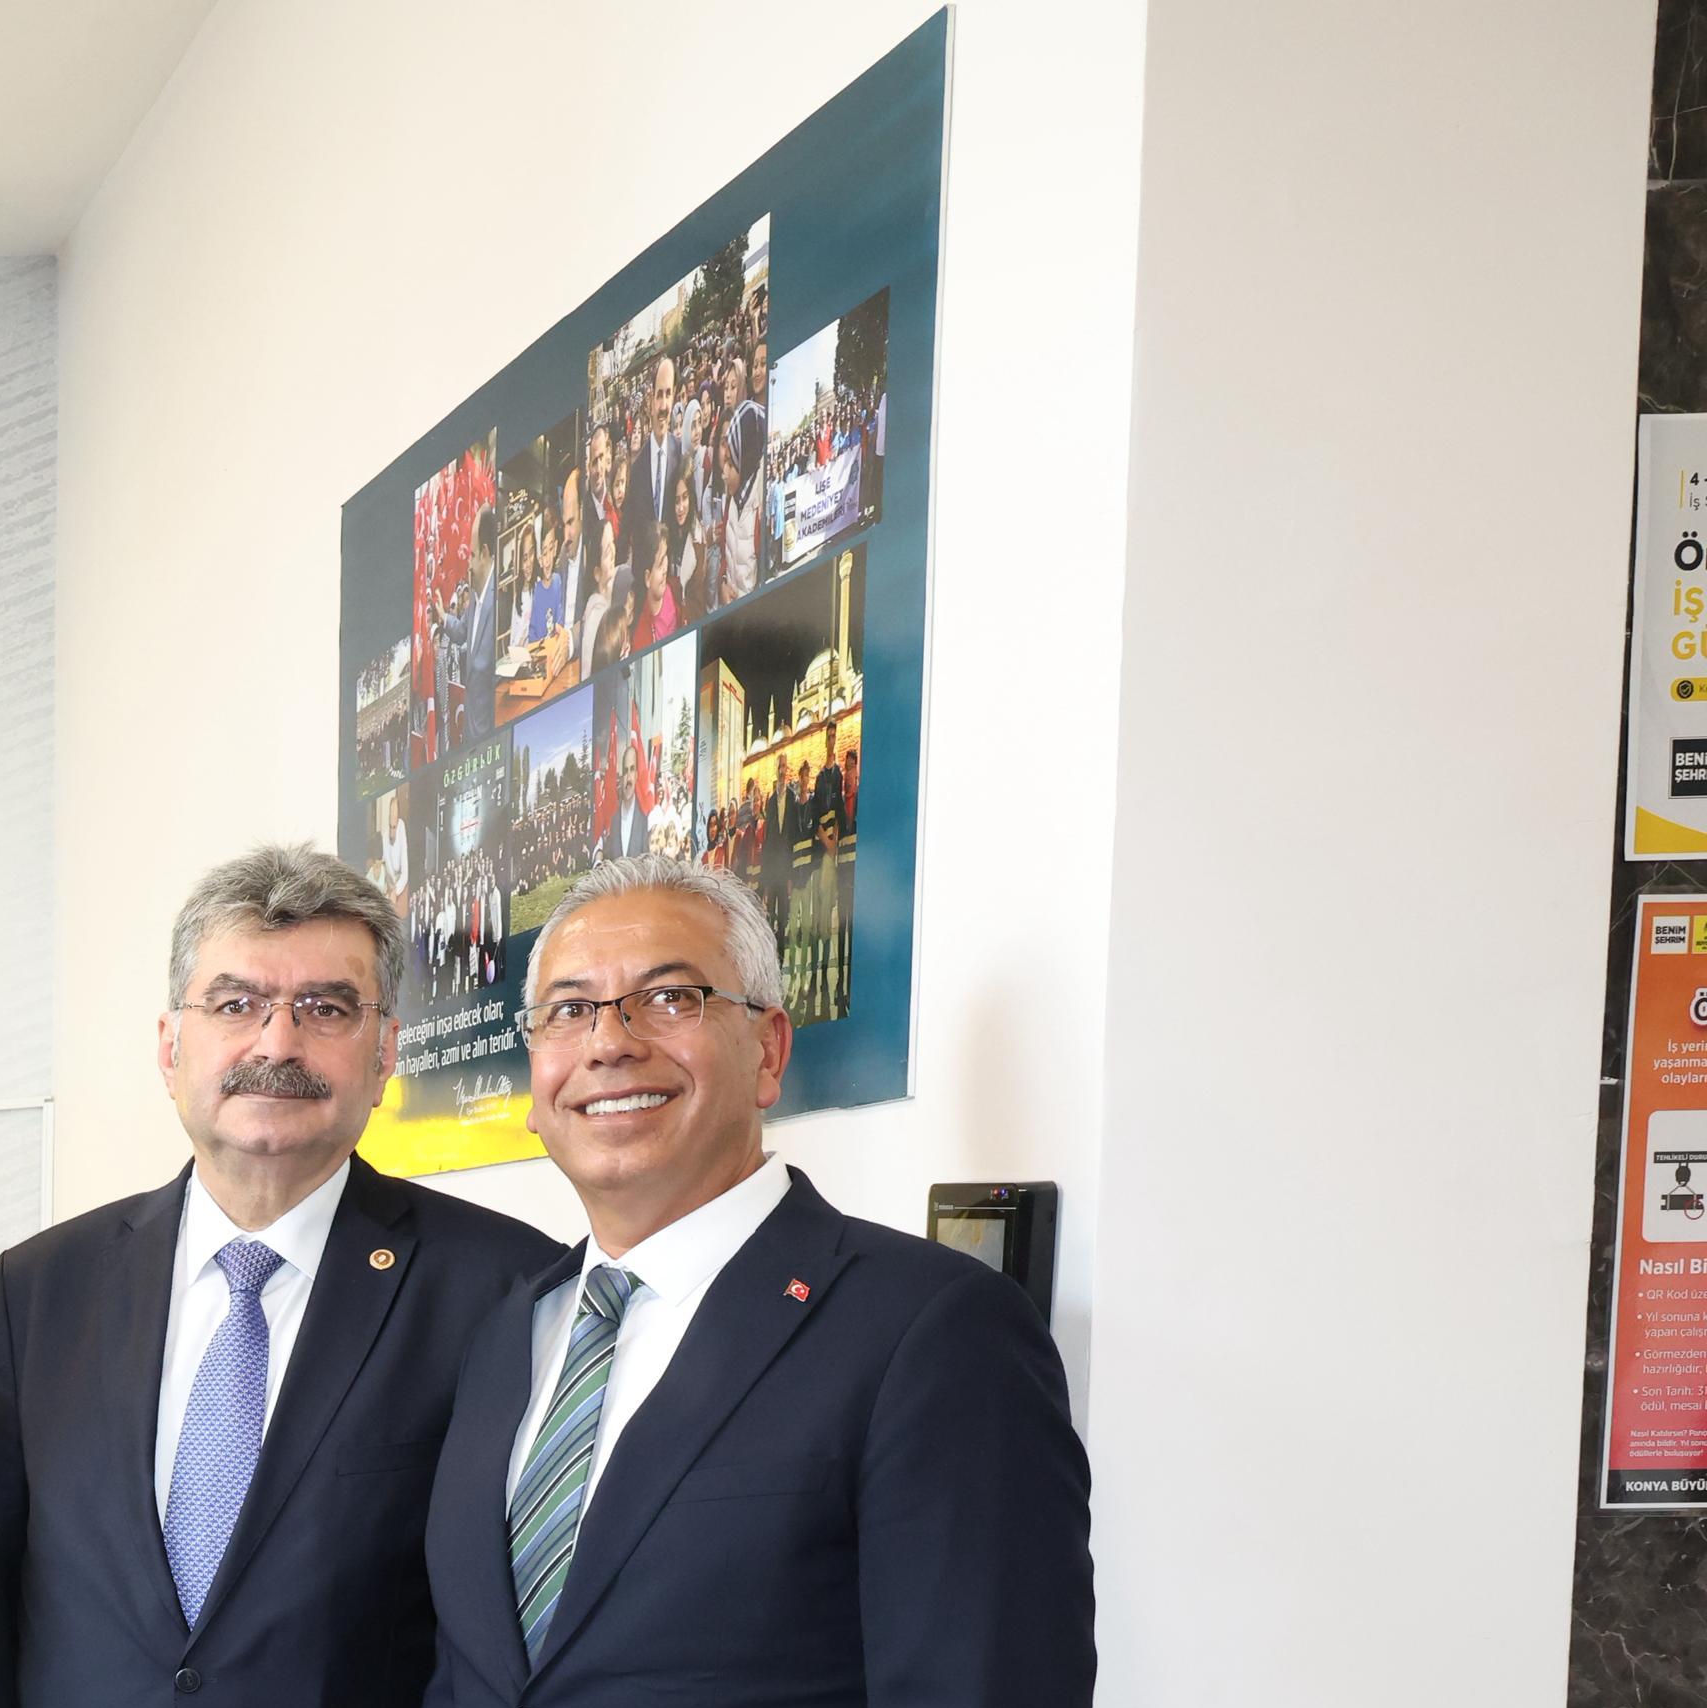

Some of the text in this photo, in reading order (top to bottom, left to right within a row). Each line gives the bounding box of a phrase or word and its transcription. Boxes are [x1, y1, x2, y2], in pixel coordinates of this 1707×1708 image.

[1690, 472, 1700, 486] 4
[1674, 531, 1707, 571] Ö
[1674, 578, 1704, 623] İŞ
[1675, 768, 1707, 783] ŞEHR
[397, 1017, 436, 1051] geleceğini
[436, 1015, 453, 1039] inşa
[454, 1003, 482, 1031] edecek
[406, 1046, 440, 1078] hayalleri,
[441, 1041, 460, 1066] azmi
[460, 1044, 472, 1061] ve
[472, 1035, 488, 1059] alın
[1639, 1258, 1684, 1275] Nasıl
[1647, 1289, 1663, 1300] QR
[1667, 1289, 1688, 1300] Kod
[1660, 1313, 1699, 1322] sonuna
[1644, 1328, 1677, 1339] yapan
[1643, 1349, 1707, 1359] Görmezden
[1642, 1386, 1662, 1396] Son
[1626, 1478, 1707, 1491] KONYA BÜYÜ
